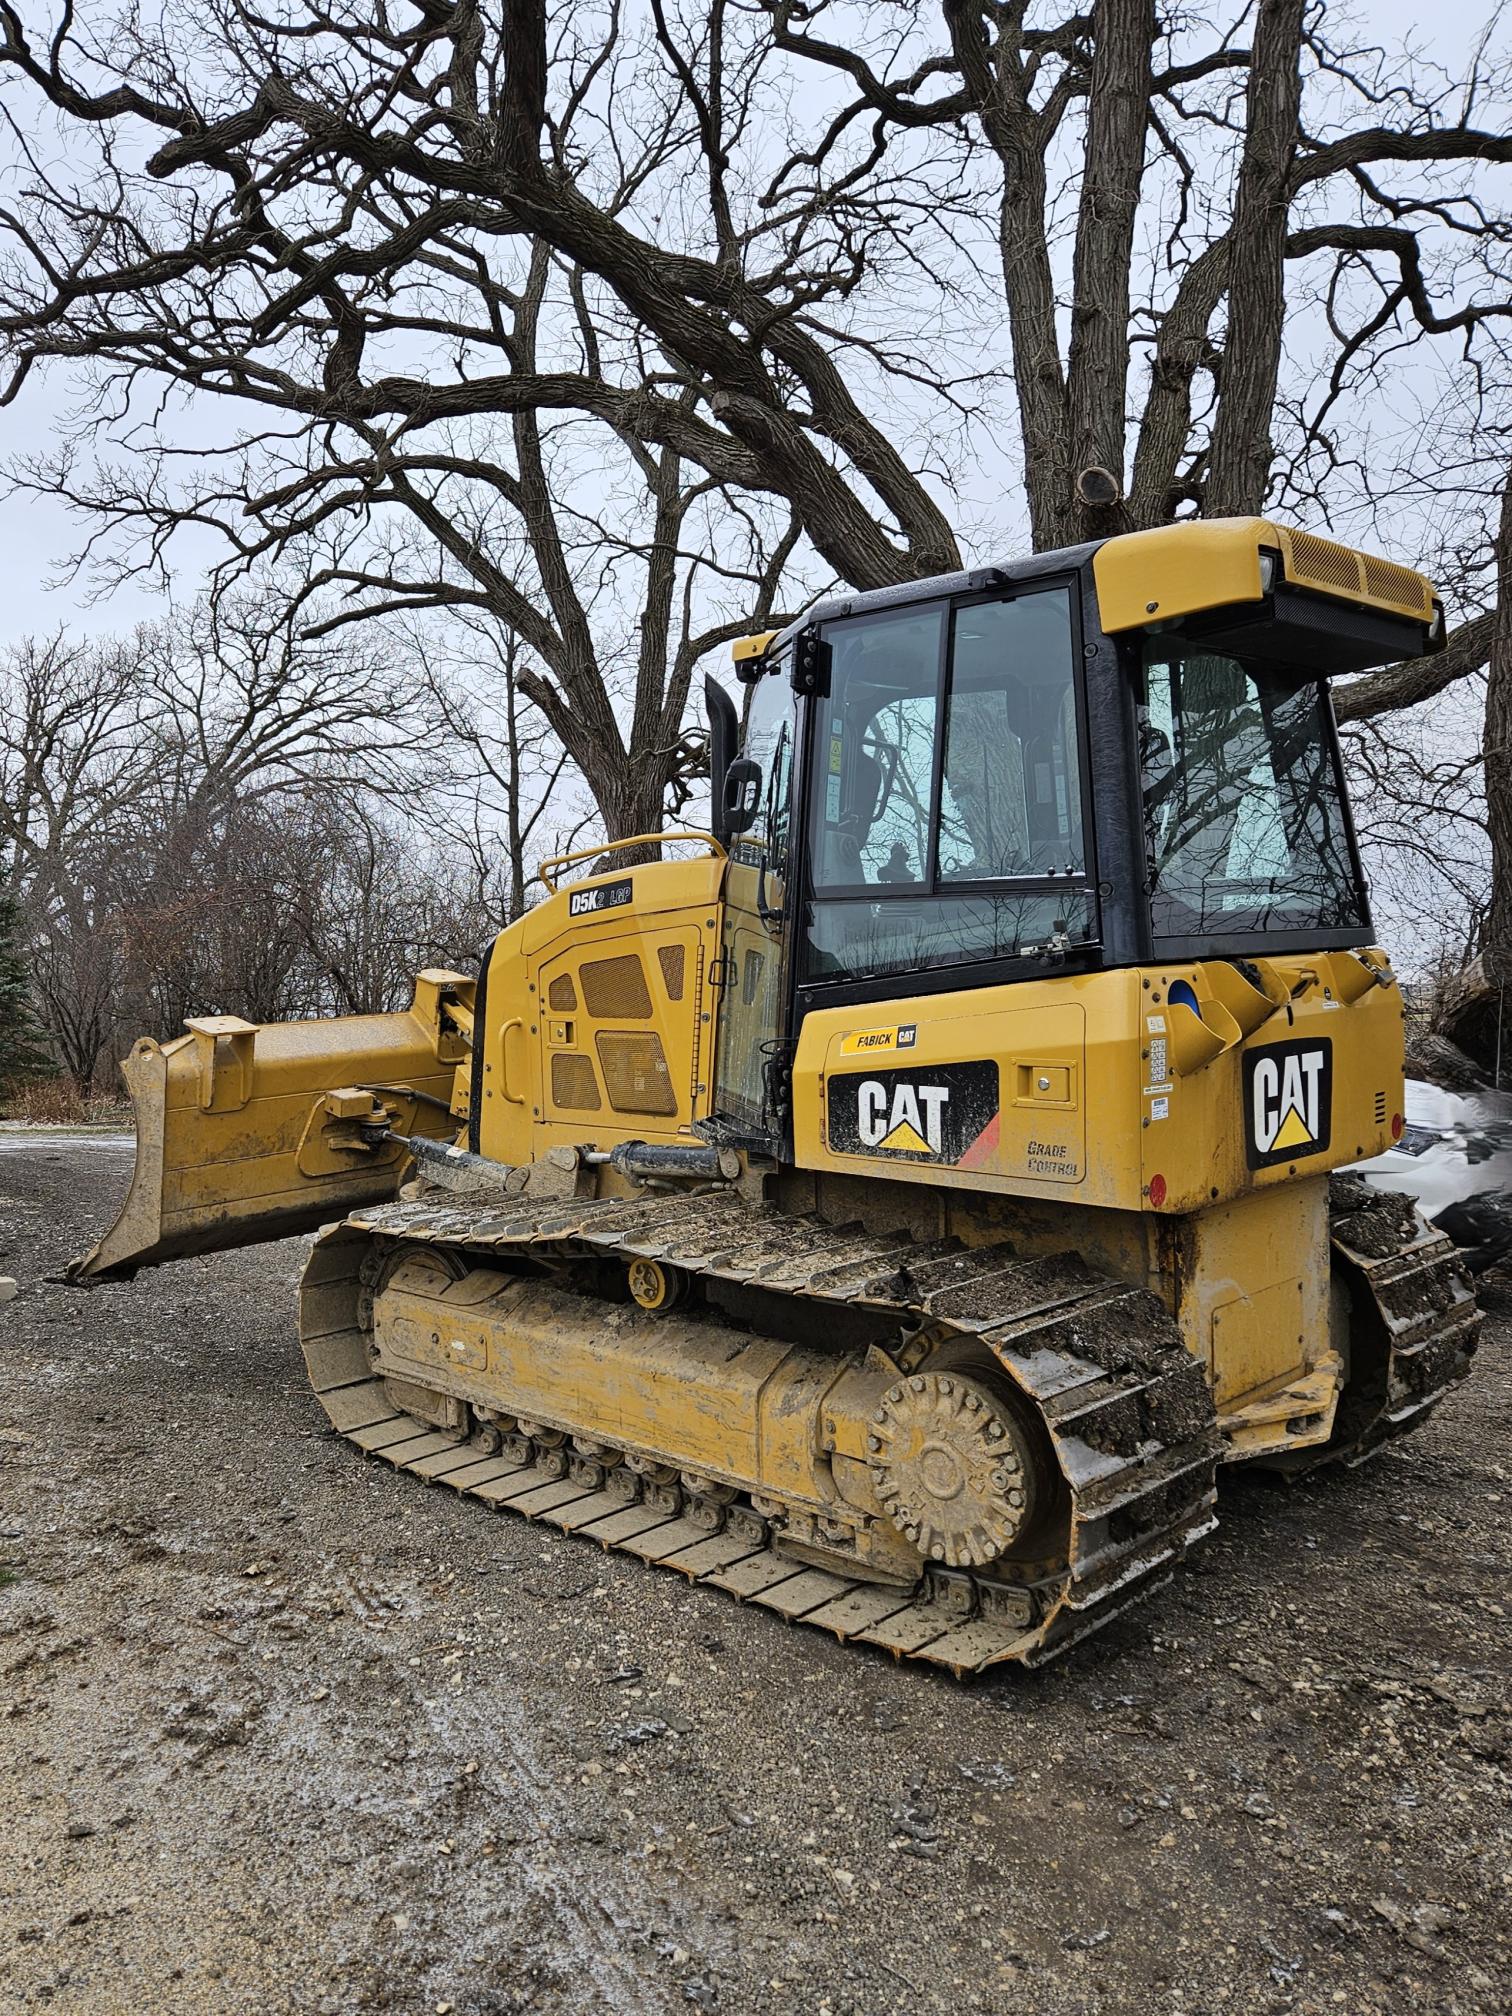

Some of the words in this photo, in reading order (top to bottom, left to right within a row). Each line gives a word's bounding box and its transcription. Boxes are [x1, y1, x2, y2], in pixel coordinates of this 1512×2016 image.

[857, 1033, 892, 1047] FABICK
[899, 1030, 914, 1042] CAT
[1253, 1051, 1324, 1152] CAT
[858, 1081, 949, 1153] CAT
[1028, 1141, 1067, 1158] GRADE
[1028, 1158, 1077, 1176] CONTROL
